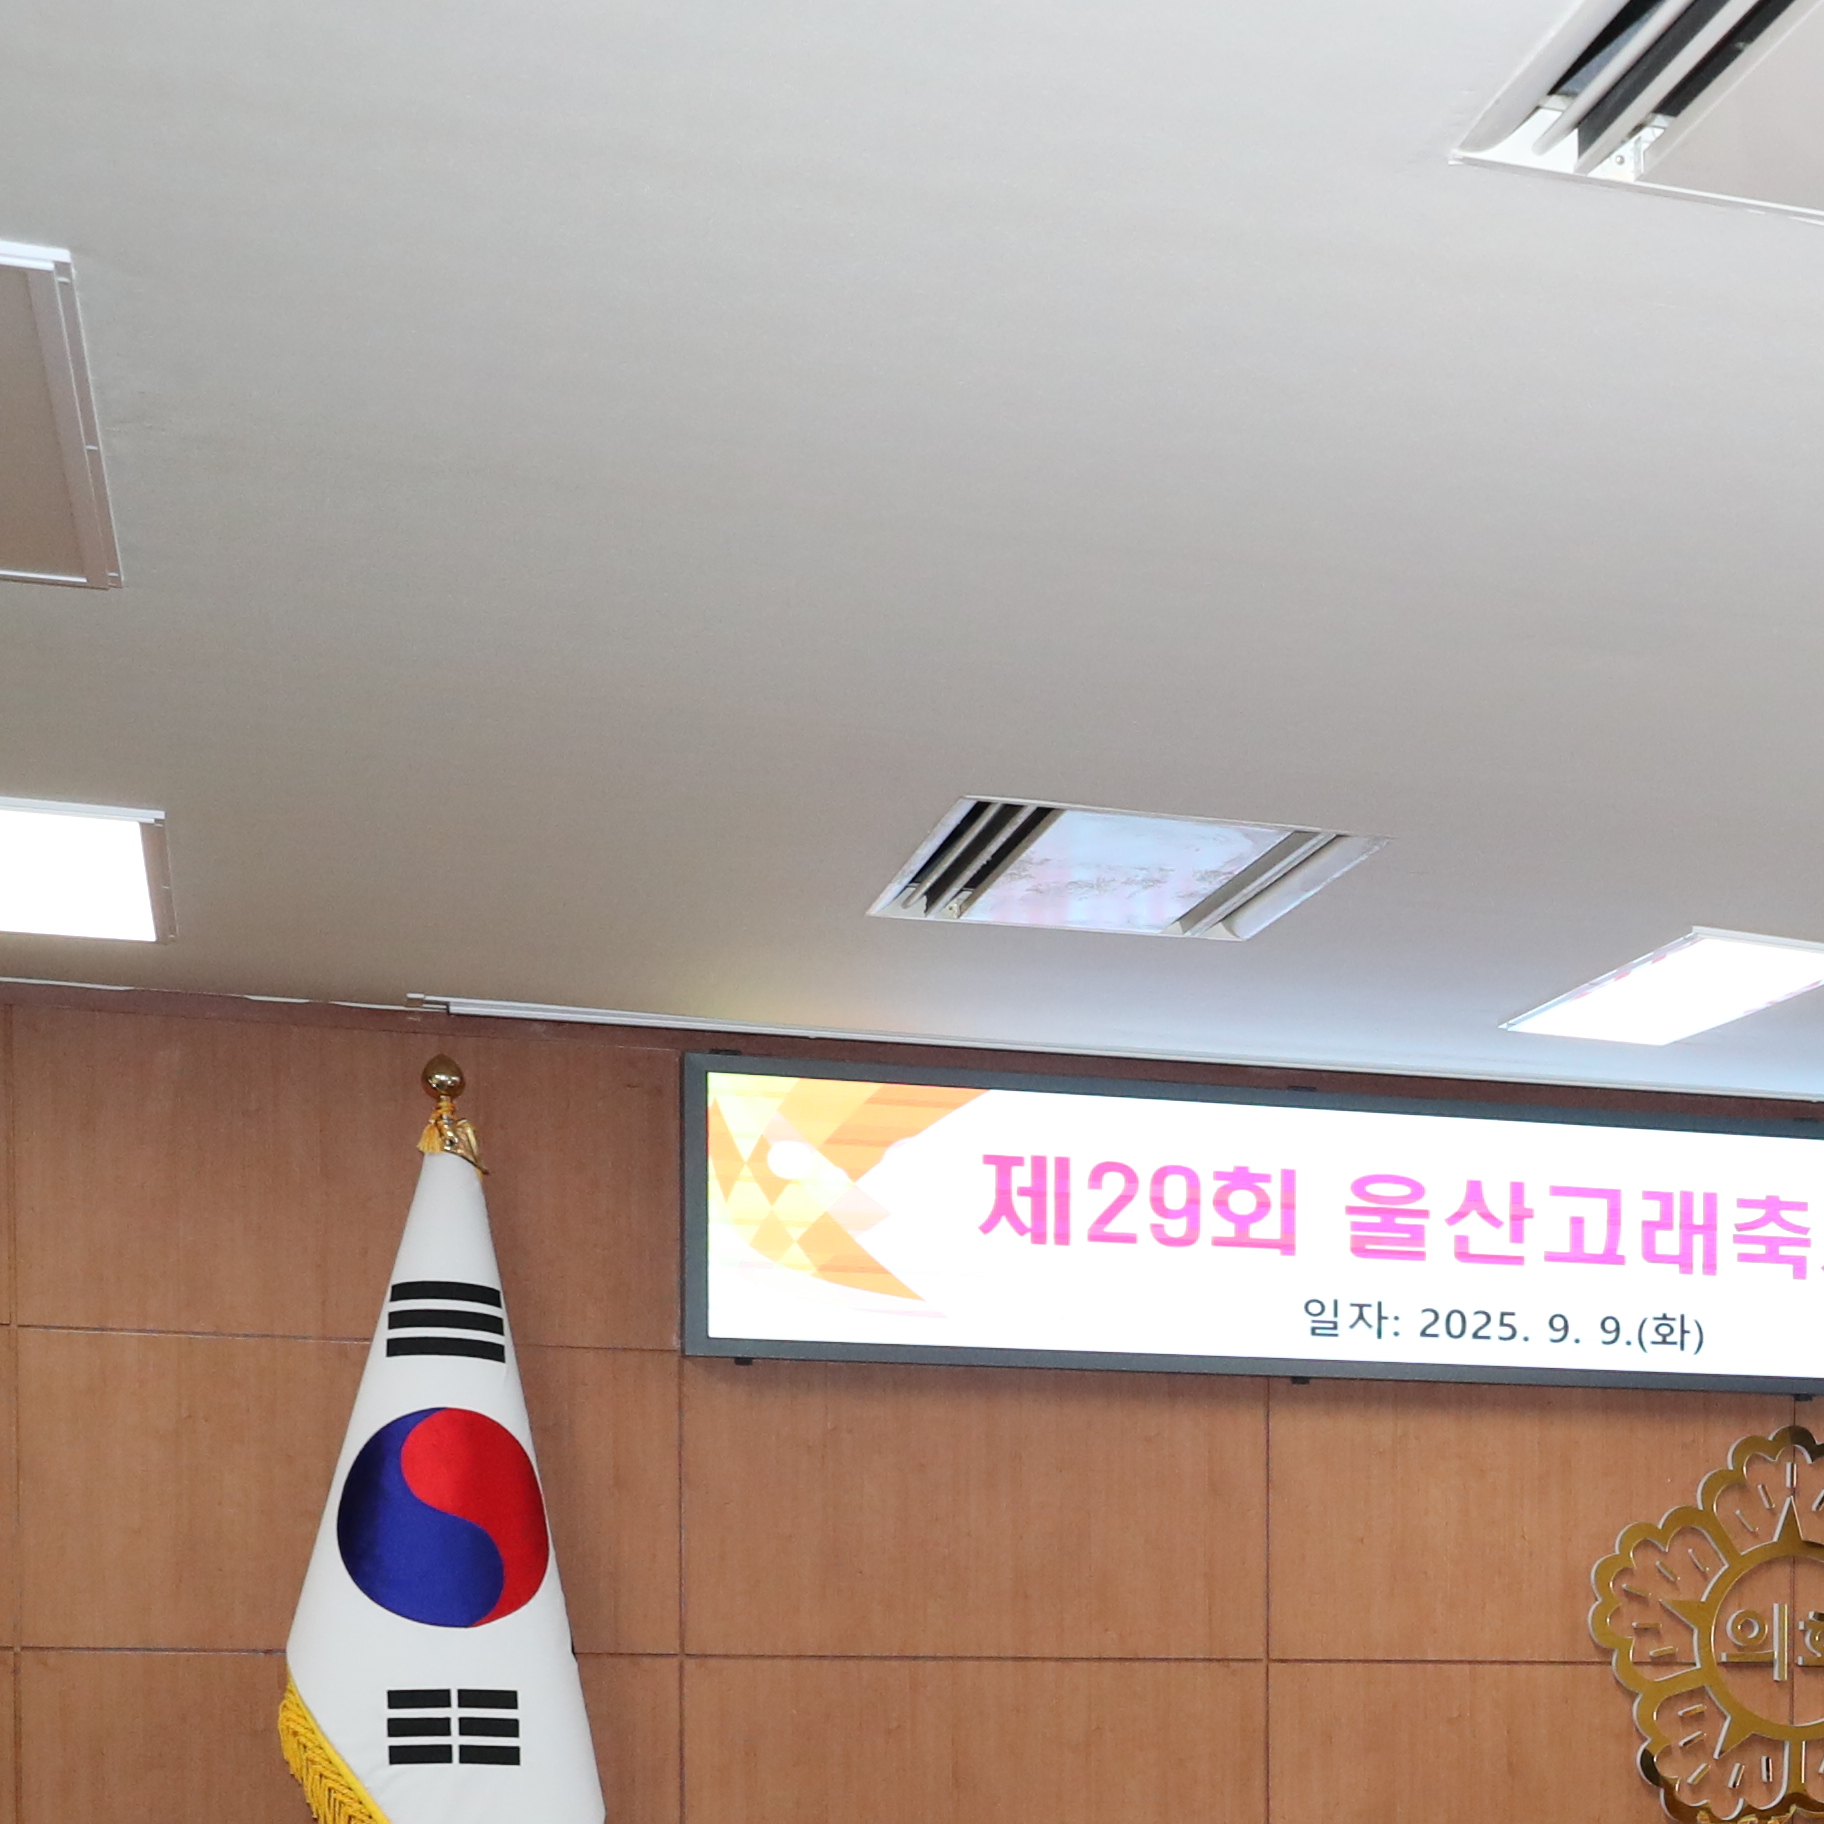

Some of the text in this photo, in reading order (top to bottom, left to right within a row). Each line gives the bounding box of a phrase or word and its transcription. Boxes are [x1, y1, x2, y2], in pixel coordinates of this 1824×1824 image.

[979, 1154, 1296, 1256] 제29회
[1304, 1299, 1399, 1339] 일자:
[1420, 1308, 1529, 1341] 2025.
[1549, 1314, 1580, 1343] 9.
[1601, 1313, 1703, 1354] 9.(화)
